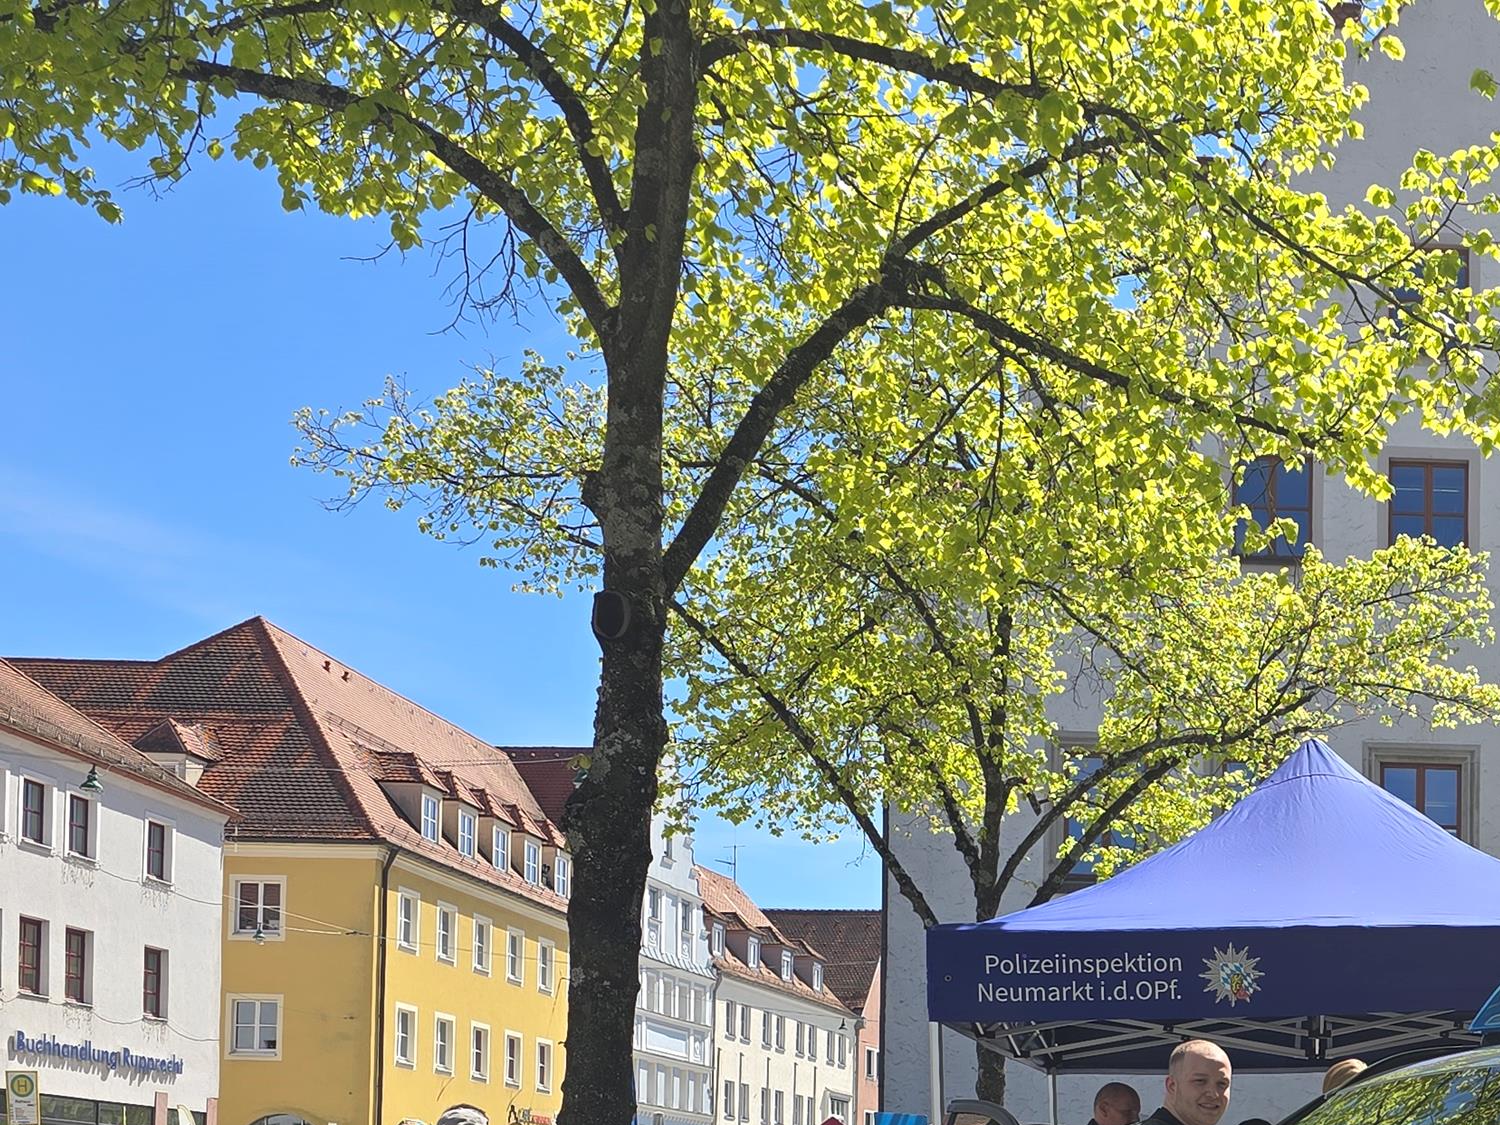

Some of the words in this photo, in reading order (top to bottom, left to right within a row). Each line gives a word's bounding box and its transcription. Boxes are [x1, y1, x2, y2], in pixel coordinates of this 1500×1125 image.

[984, 953, 1183, 978] Polizeiinspektion
[977, 980, 1094, 1002] Neumarkt
[16, 1030, 118, 1070] Buchhandlung
[122, 1047, 184, 1075] Rupprecht
